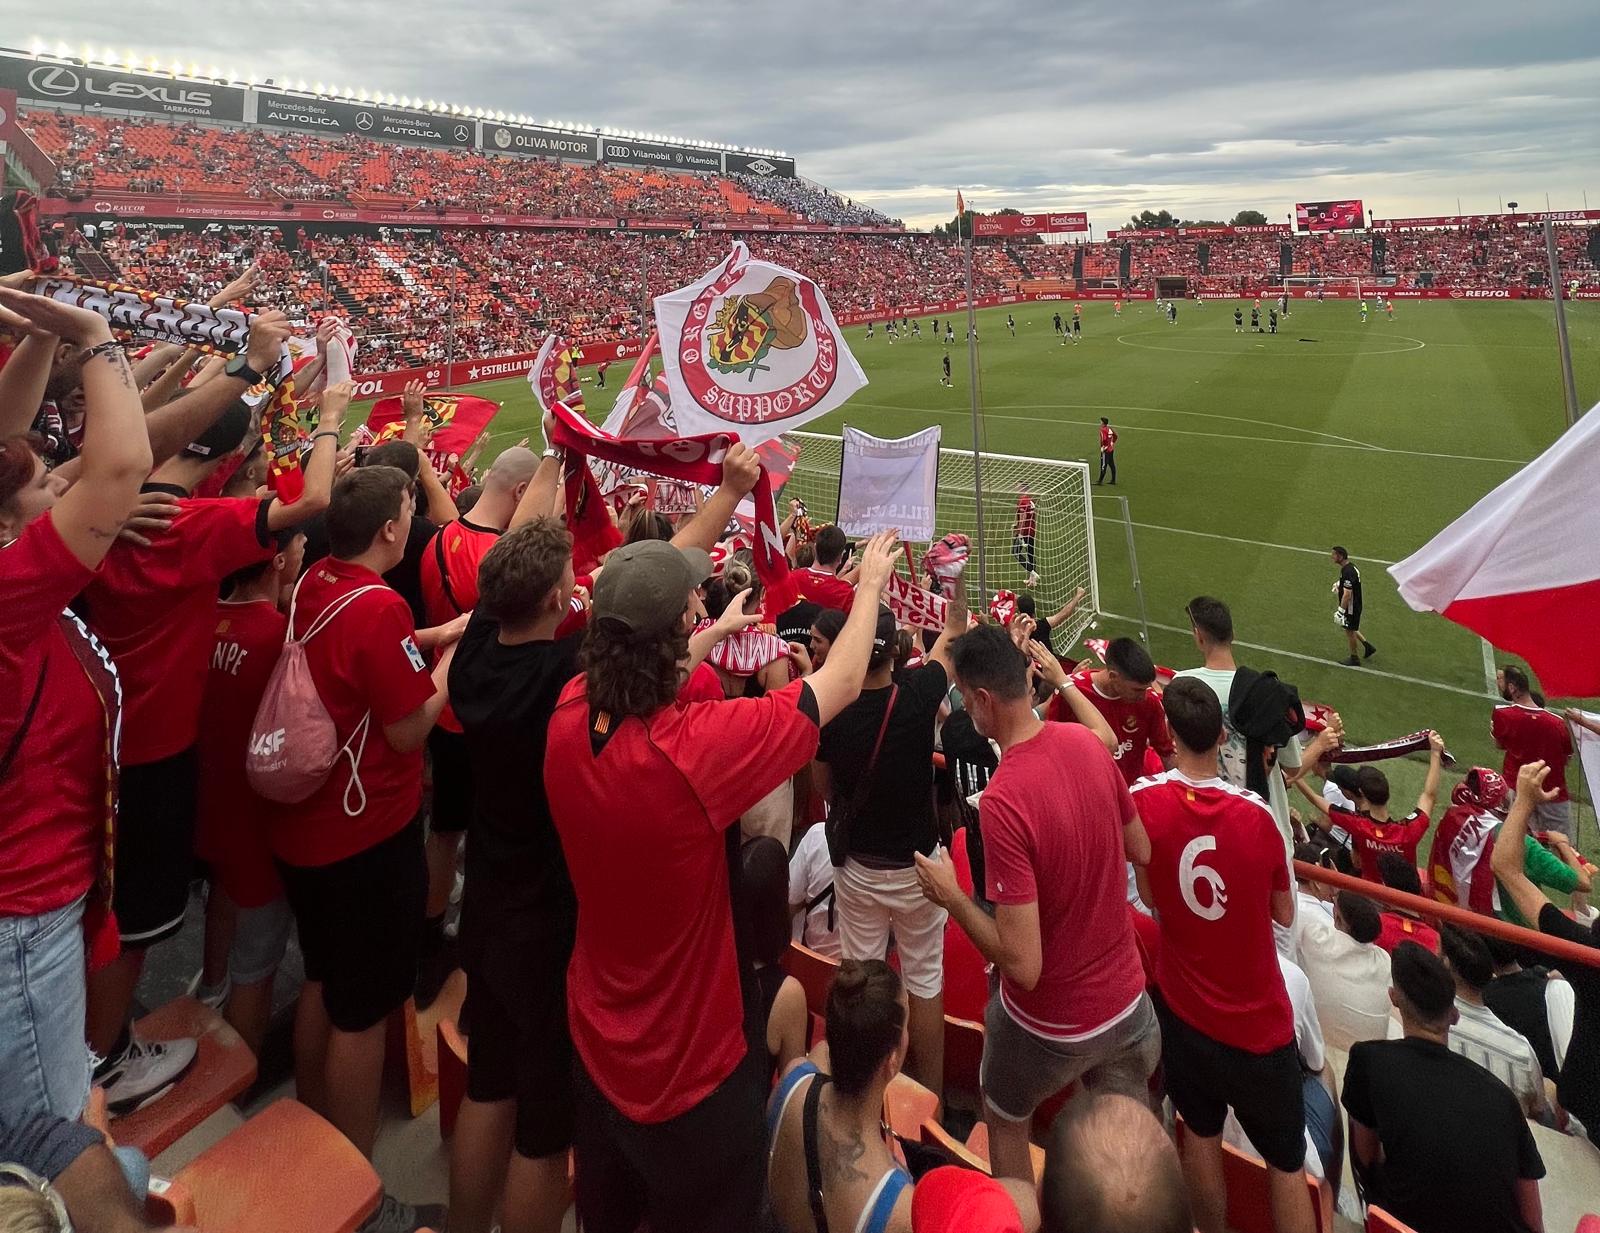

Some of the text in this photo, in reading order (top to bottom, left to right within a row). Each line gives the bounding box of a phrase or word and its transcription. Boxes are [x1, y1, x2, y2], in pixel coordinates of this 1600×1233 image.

[85, 78, 212, 107] LEXUS
[163, 104, 211, 115] TARRAGONA
[268, 100, 327, 115] Mercedes-Benz
[268, 112, 340, 127] AUTOLICA
[383, 115, 431, 128] Mercedes-Benz
[383, 126, 442, 139] AUTOLICA
[515, 135, 588, 153] OLIVA MOTOR
[632, 149, 671, 161] Vilamòbil
[685, 155, 719, 166] Vilamòbil
[481, 359, 535, 376] ESTRELLA DA
[1178, 834, 1228, 921] 6
